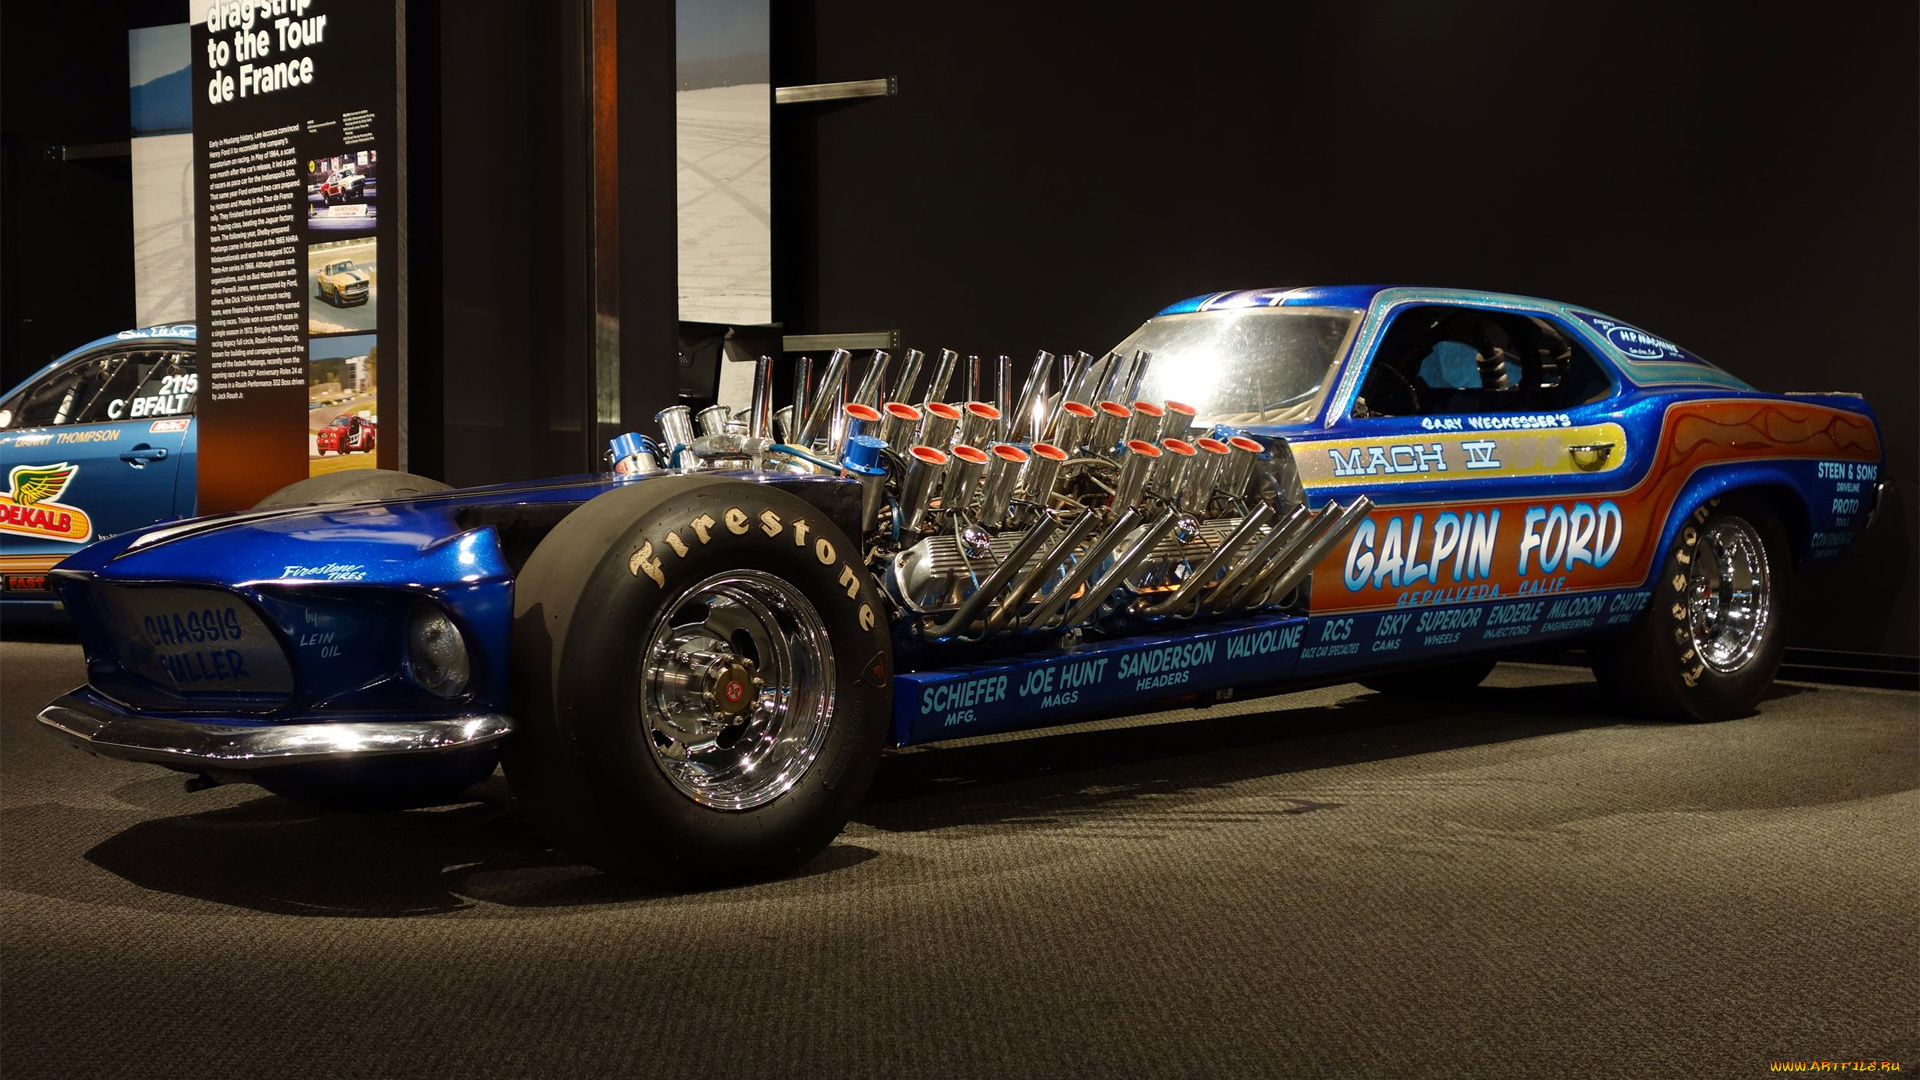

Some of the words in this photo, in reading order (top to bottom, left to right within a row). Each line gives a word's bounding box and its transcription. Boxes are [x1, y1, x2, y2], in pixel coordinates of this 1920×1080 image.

[208, 0, 254, 33] drag
[208, 38, 229, 68] to
[235, 28, 270, 62] the
[275, 14, 326, 51] Tour
[208, 70, 234, 104] de
[240, 57, 313, 97] France
[159, 373, 198, 395] 2115
[1422, 417, 1463, 430] GARY
[1468, 414, 1571, 429] WECKESSER'S
[56, 430, 120, 444] THOMPSON
[1328, 443, 1447, 477] MACH
[1460, 441, 1501, 470] IV
[1818, 462, 1845, 479] STEEN
[1848, 464, 1853, 479] &
[1856, 464, 1878, 480] SONS
[1837, 482, 1860, 493] DRIVELINE
[1832, 498, 1859, 514] PROTO
[0, 504, 72, 532] DEKALB
[1343, 508, 1501, 593] GALPIN
[1518, 499, 1624, 577] FORD
[280, 563, 364, 580] Firestone
[328, 572, 367, 580] TIRES
[628, 506, 876, 632] Firestone
[9, 577, 45, 590] FAST
[1518, 576, 1570, 597] CALIF.
[144, 608, 242, 647] CHASSIS
[304, 608, 318, 626] by
[1321, 618, 1354, 642] RCS
[1375, 614, 1412, 637] ISKY
[1416, 607, 1482, 632] SUPERIOR
[1487, 602, 1542, 626] ENDERLE
[1548, 595, 1607, 620] MILODON
[1609, 592, 1651, 613] CHUTE
[300, 632, 335, 647] LEIN
[1372, 638, 1401, 652] CAMS
[1424, 632, 1461, 646] WHEELS
[1483, 624, 1532, 639] INJECTORS
[1540, 618, 1594, 632] ENGINEERING
[1606, 613, 1632, 625] METAL
[321, 645, 341, 658] OIL
[1300, 647, 1316, 660] RACE
[1316, 646, 1328, 658] CAR
[920, 675, 1008, 715] SCHIEFER
[1018, 667, 1054, 697] JOE
[1059, 658, 1109, 689] HUNT
[1118, 640, 1216, 680] SANDERSON
[1226, 625, 1303, 660] VALVOLINE
[942, 709, 977, 727] MFG.
[1040, 691, 1079, 710] MAGS
[1136, 671, 1189, 691] HEADERS
